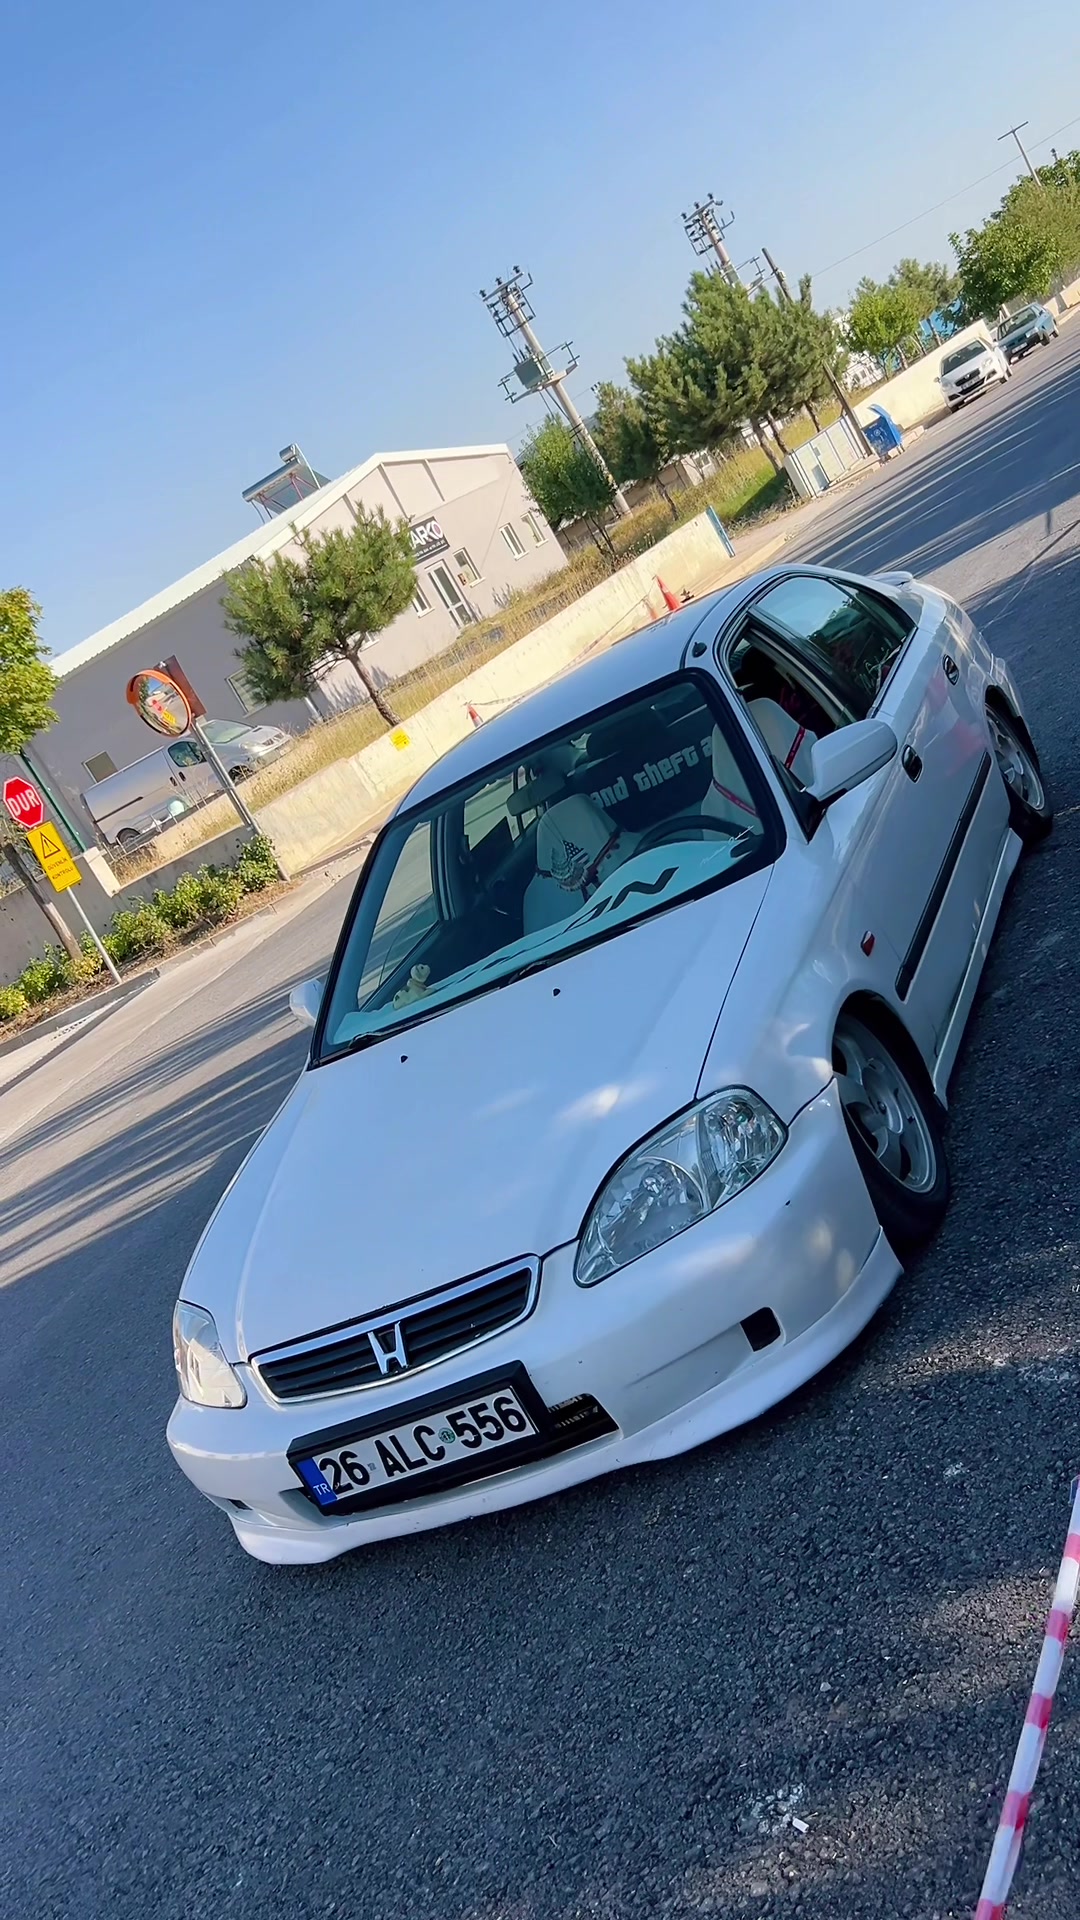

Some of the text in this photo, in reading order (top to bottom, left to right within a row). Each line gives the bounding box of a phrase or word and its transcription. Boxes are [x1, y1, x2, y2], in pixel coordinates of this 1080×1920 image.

[633, 745, 699, 792] theft
[7, 789, 40, 816] DUR
[318, 1396, 527, 1495] 26 ALC 556
[313, 1484, 331, 1496] TR
